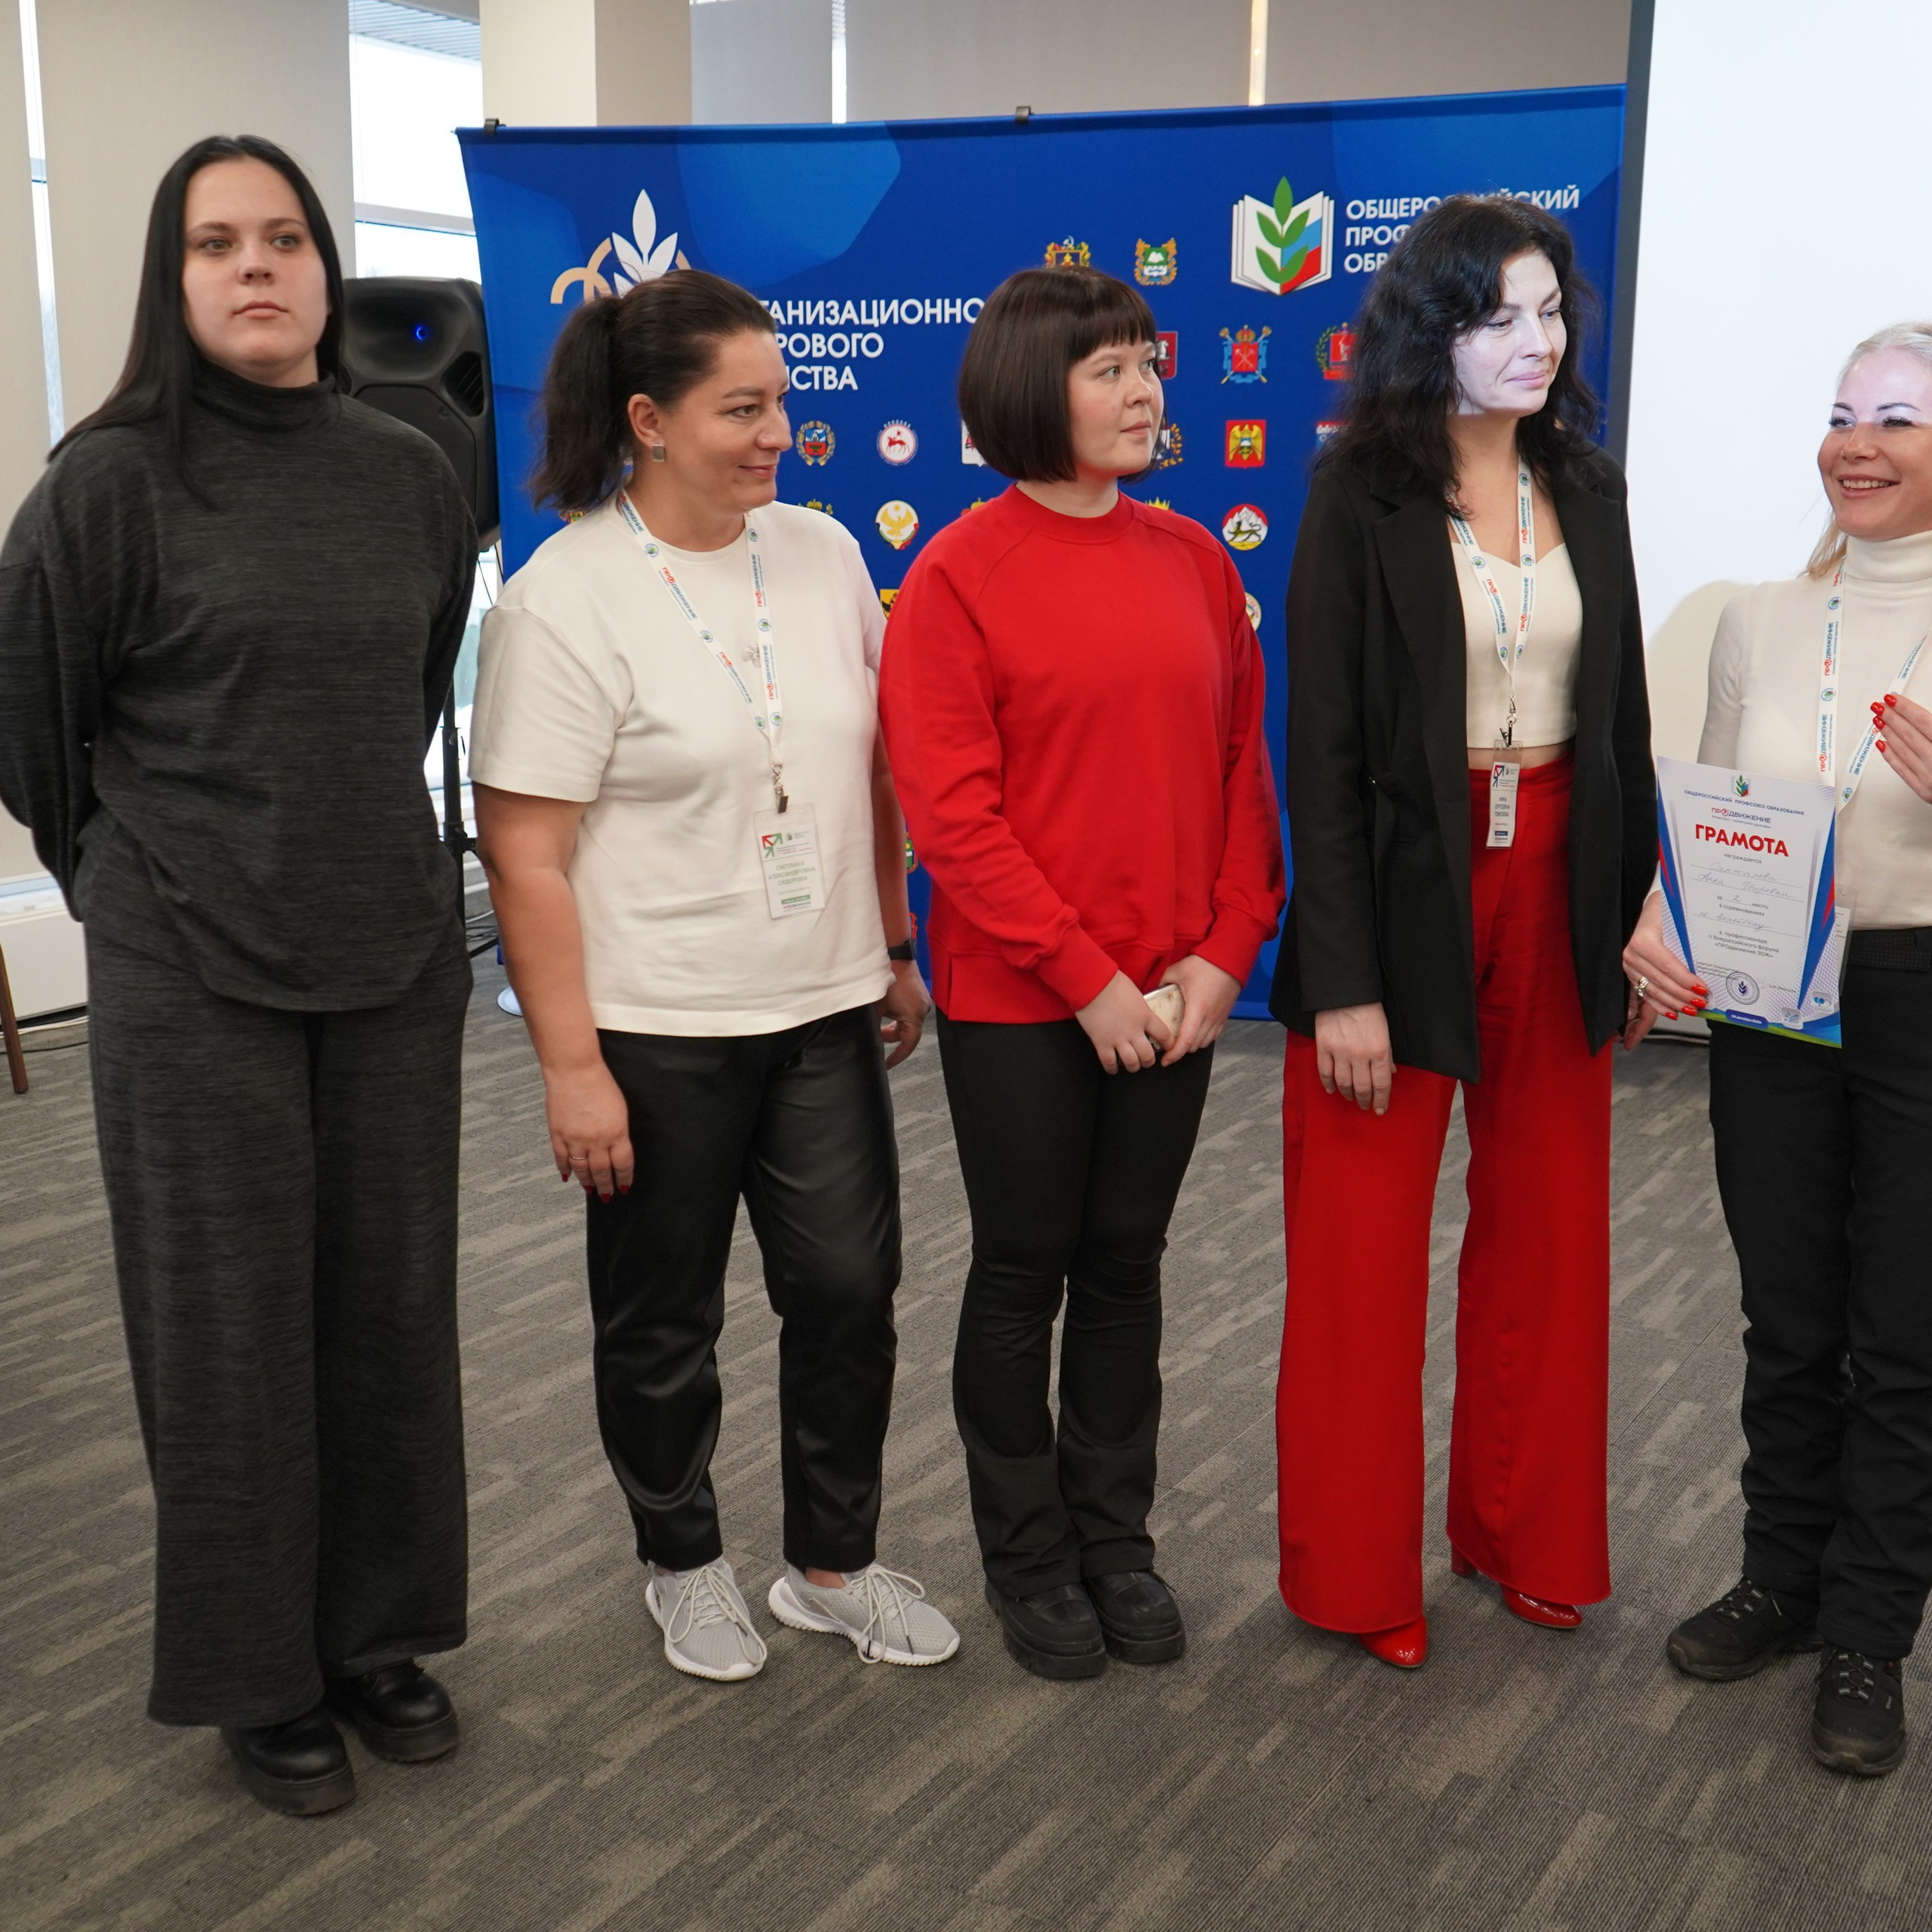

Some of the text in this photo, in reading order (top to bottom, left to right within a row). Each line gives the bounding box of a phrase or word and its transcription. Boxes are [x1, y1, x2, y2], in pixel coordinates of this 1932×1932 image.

[786, 365, 858, 390] СТВА
[1684, 789, 1804, 816] ОБЩЕРОССИЙСКИЙ ПРОФСОЮЗ ОБРАЗОВАНИЯ
[1695, 823, 1789, 857] ГРАМОТА
